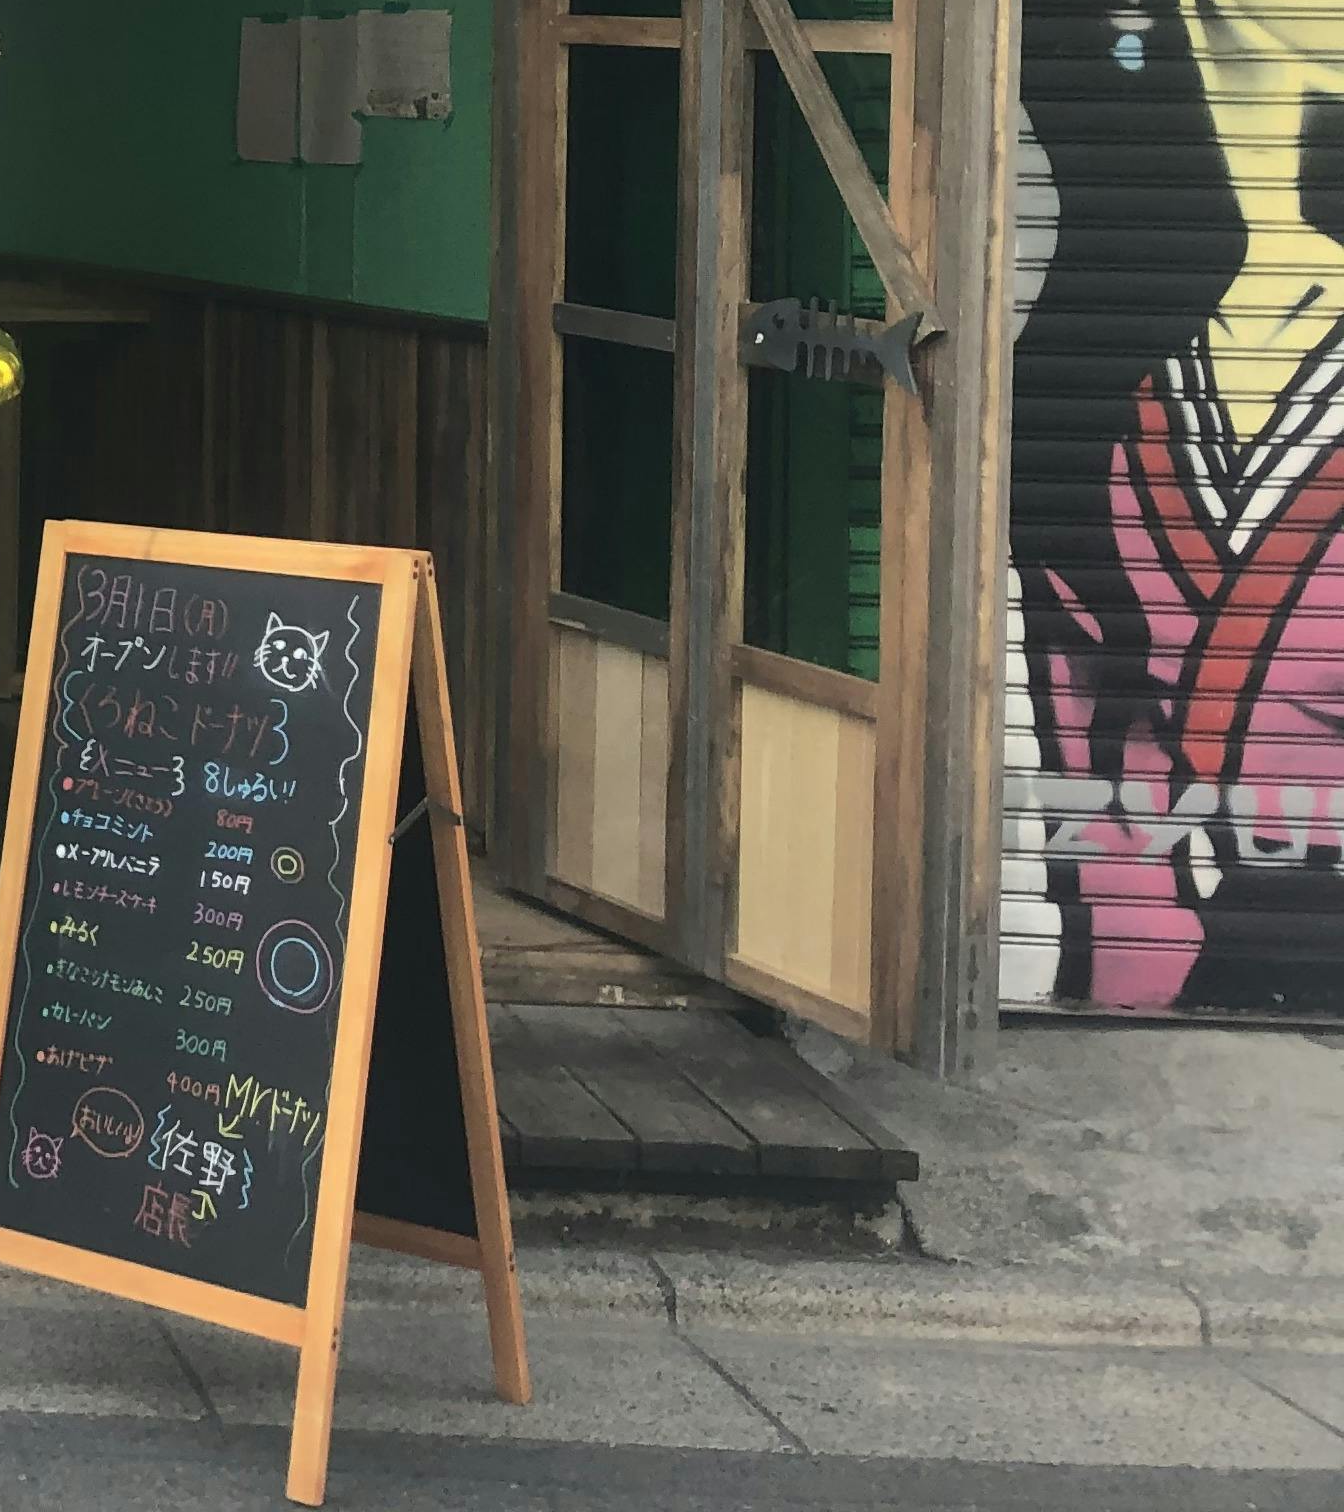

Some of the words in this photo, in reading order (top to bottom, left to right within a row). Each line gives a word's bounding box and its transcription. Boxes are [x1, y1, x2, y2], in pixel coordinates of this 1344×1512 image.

[216, 808, 254, 834] 80円
[204, 841, 254, 865] 200円
[199, 870, 252, 895] 150円
[193, 902, 244, 931] 300円
[186, 941, 245, 975] 250円
[178, 984, 233, 1017] 250円
[175, 1028, 227, 1063] 300円
[166, 1071, 221, 1106] 400円
